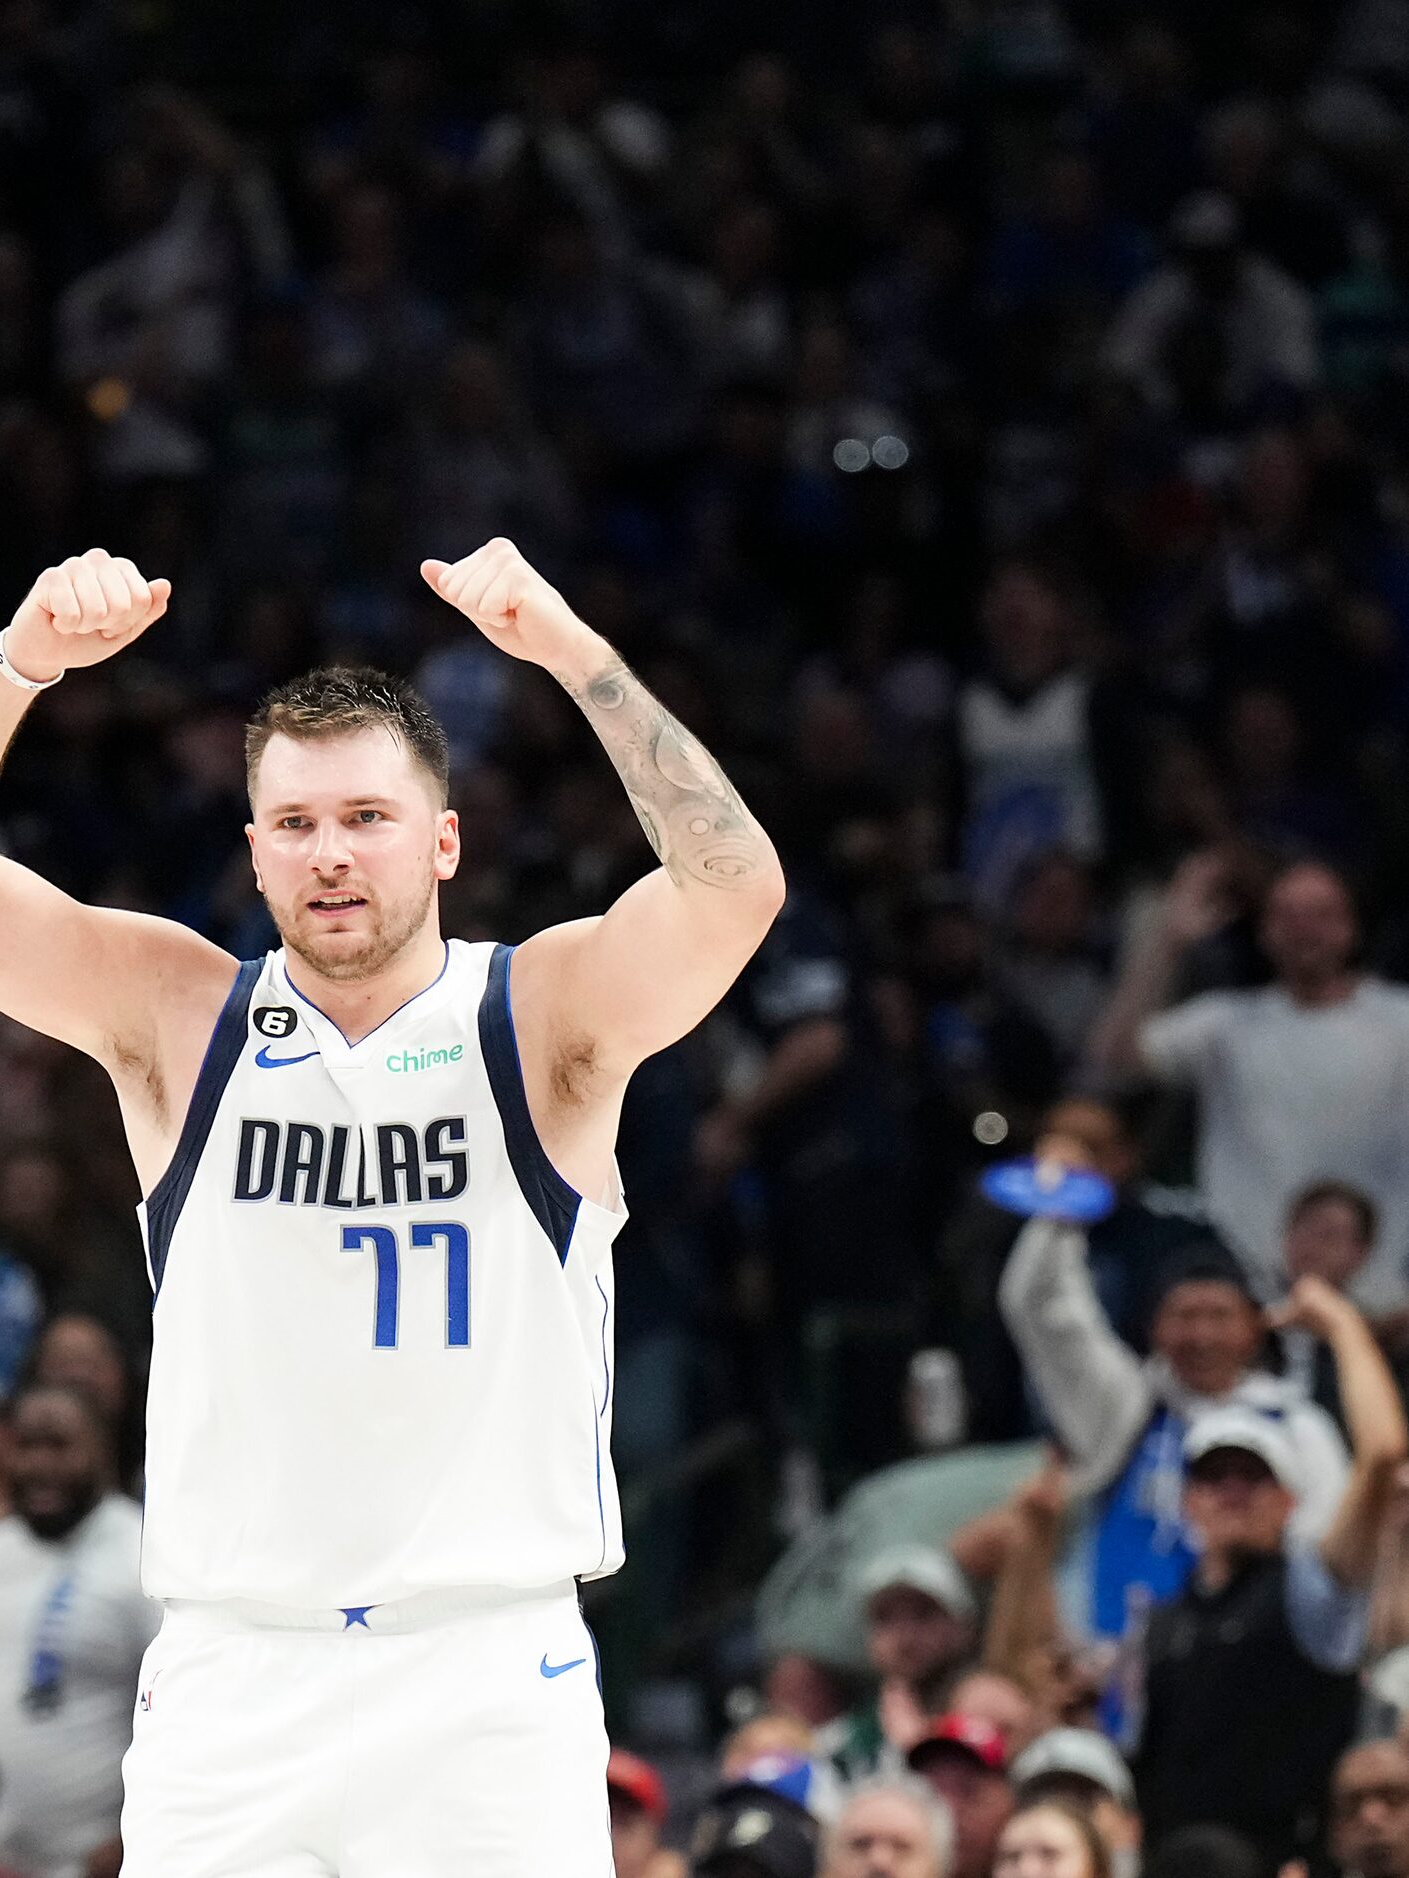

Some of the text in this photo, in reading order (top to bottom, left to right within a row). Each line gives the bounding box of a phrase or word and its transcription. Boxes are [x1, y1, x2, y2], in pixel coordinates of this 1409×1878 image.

[261, 1011, 289, 1036] 6
[386, 1044, 464, 1073] chime
[231, 1115, 471, 1211] DALLAS
[340, 1220, 471, 1350] 77
